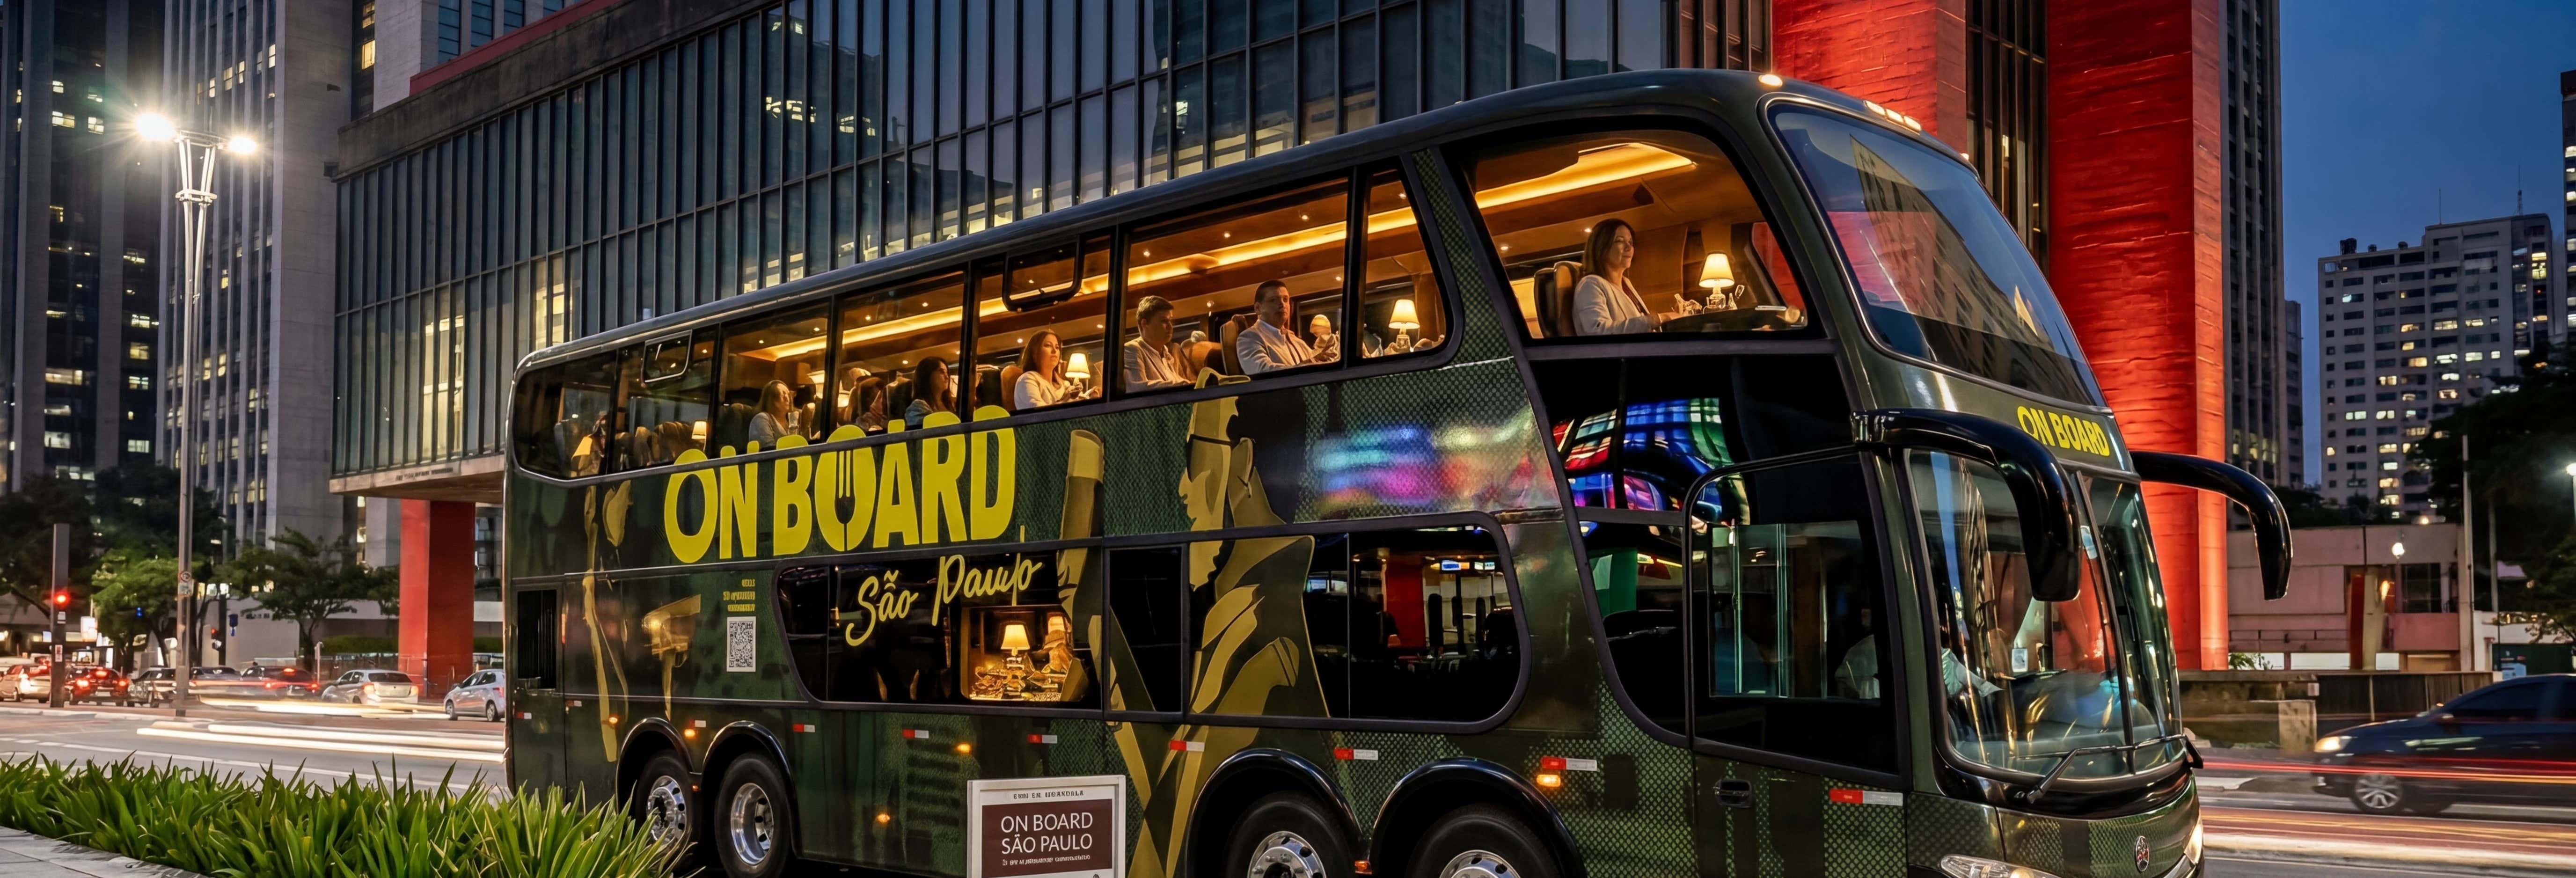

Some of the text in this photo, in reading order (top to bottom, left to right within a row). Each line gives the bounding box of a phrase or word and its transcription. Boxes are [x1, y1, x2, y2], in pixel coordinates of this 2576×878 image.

[2017, 406, 2110, 456] ON BOARD
[664, 405, 1017, 563] ON BOARD
[845, 570, 919, 647] São
[1001, 812, 1093, 833] ON BOARD
[1001, 833, 1093, 855] SÃO PAULO
